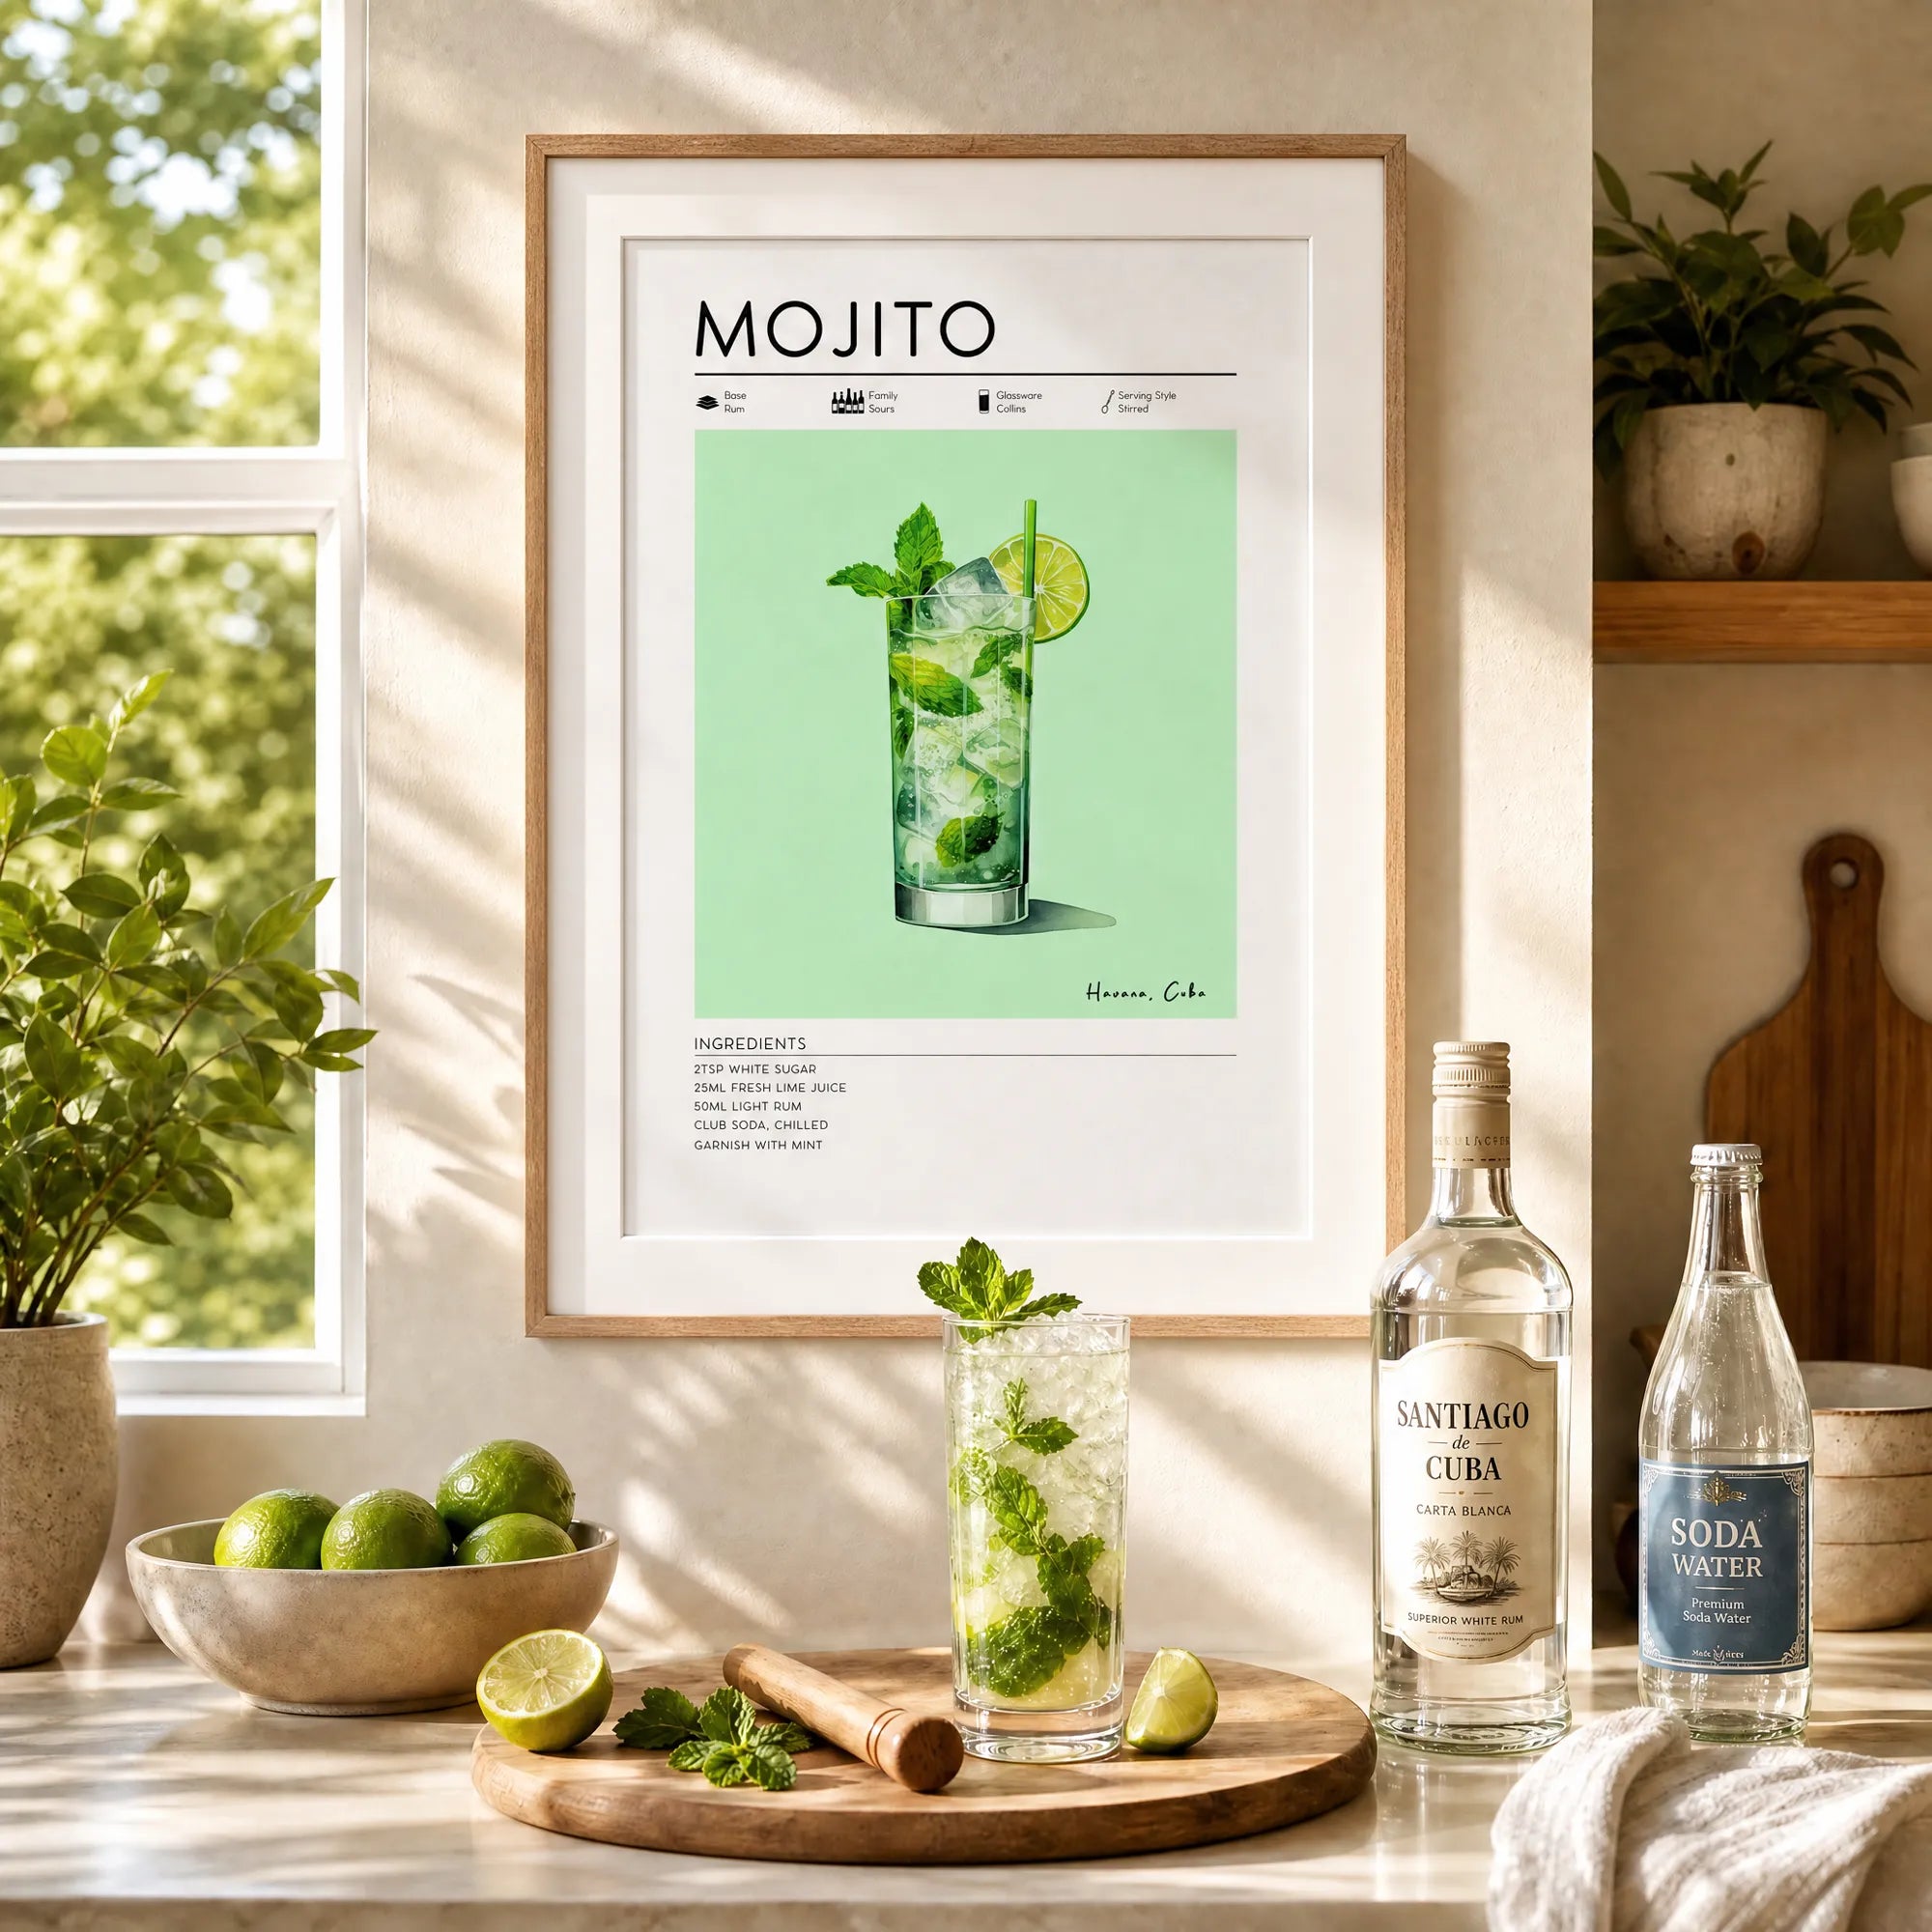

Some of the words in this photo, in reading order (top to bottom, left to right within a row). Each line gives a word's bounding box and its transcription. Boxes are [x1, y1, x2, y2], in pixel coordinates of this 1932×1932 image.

[695, 299, 996, 358] MOJITO
[724, 389, 748, 401] Base
[867, 389, 899, 404] Family
[995, 389, 1043, 402] Glassware
[1118, 389, 1152, 405] Serving
[1154, 389, 1178, 404] Style
[724, 403, 746, 414] Rum
[867, 403, 896, 414] Sours
[996, 403, 1027, 414] Collins
[1118, 403, 1151, 414] Stirred
[1085, 980, 1153, 1003] Havana,
[694, 1036, 808, 1052] INGREDIENTS
[694, 1063, 724, 1075] 2TSP
[728, 1063, 770, 1075] WHITE
[774, 1063, 817, 1075] SUGAR
[694, 1082, 727, 1094] 25ML
[730, 1082, 772, 1094] FRESH
[776, 1082, 807, 1094] LIME
[810, 1082, 847, 1094] JUICE
[694, 1100, 727, 1112] 50ML
[731, 1100, 769, 1112] LIGHT
[773, 1100, 802, 1112] RUM
[694, 1120, 727, 1130] CLUB
[731, 1120, 770, 1132] SODA,
[774, 1120, 829, 1130] CHILLED
[694, 1139, 751, 1151] GARNISH
[753, 1139, 787, 1151] WITH
[791, 1139, 823, 1151] MINT
[1397, 1400, 1529, 1430] SANTIAGO
[1452, 1435, 1470, 1450] de
[1426, 1456, 1502, 1482] CUBA
[1416, 1504, 1457, 1517] CARTA
[1462, 1505, 1512, 1517] BLANCA
[1671, 1518, 1763, 1548] SODA
[1672, 1553, 1764, 1577] WATER
[1691, 1598, 1745, 1609] Premium
[1407, 1611, 1458, 1625] SUPERIOR
[1461, 1616, 1498, 1626] WHITE
[1501, 1614, 1523, 1625] RUM
[1683, 1610, 1711, 1623] Soda
[1715, 1612, 1751, 1624] Water
